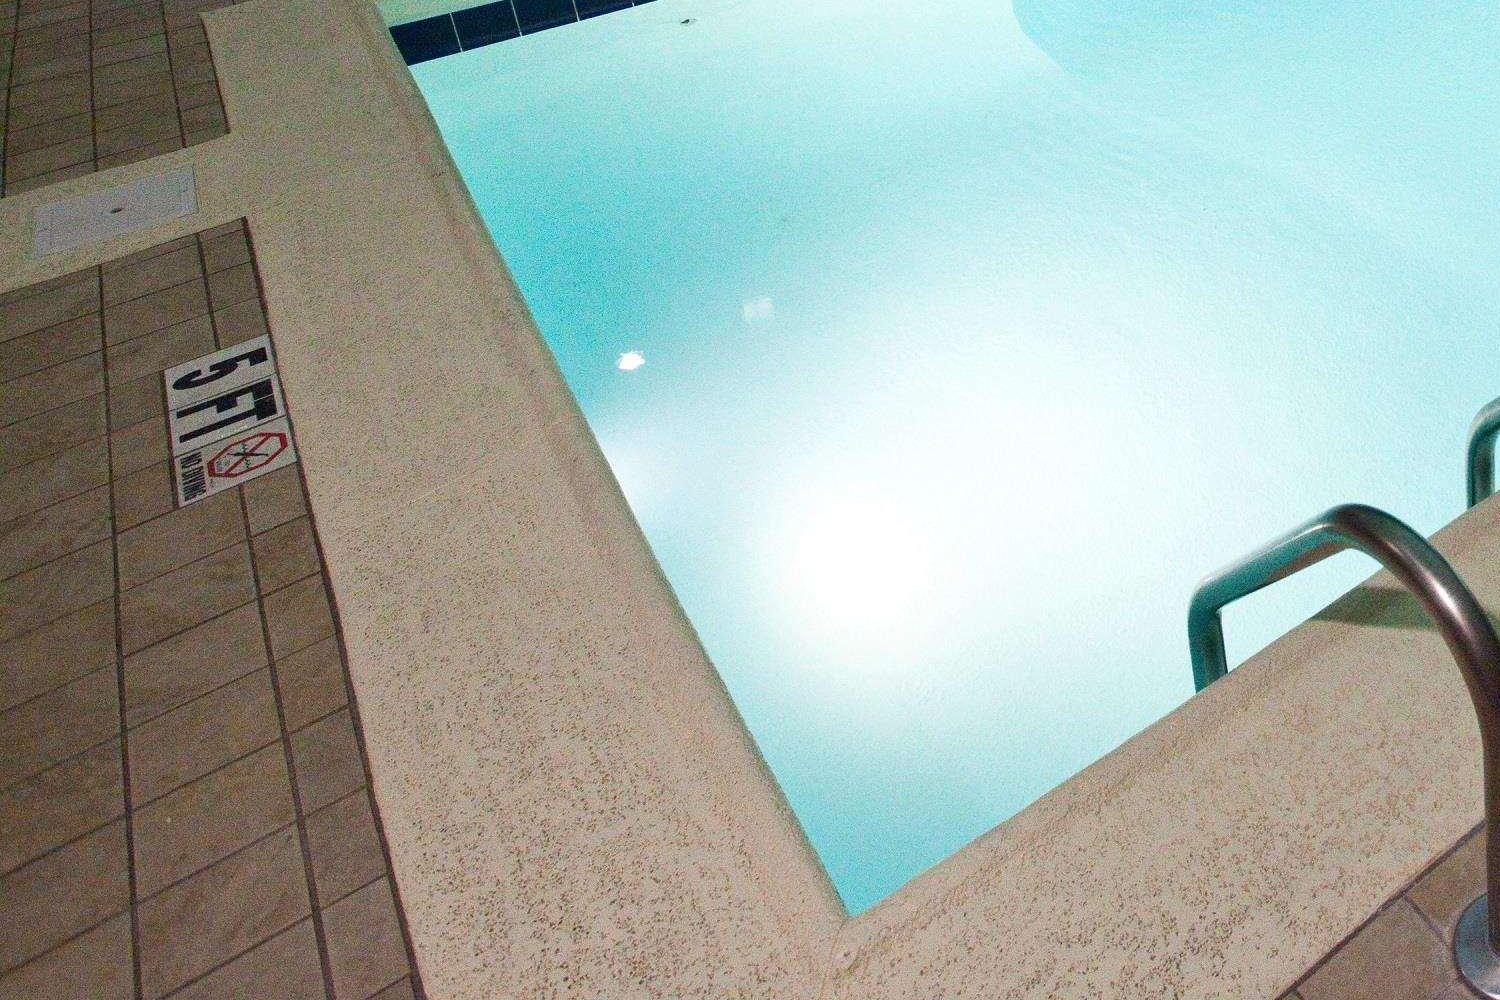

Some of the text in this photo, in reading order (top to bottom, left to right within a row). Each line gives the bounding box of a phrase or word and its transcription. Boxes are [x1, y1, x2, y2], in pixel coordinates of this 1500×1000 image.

[171, 346, 278, 443] 5 FT
[180, 451, 207, 502] NO DIVING
